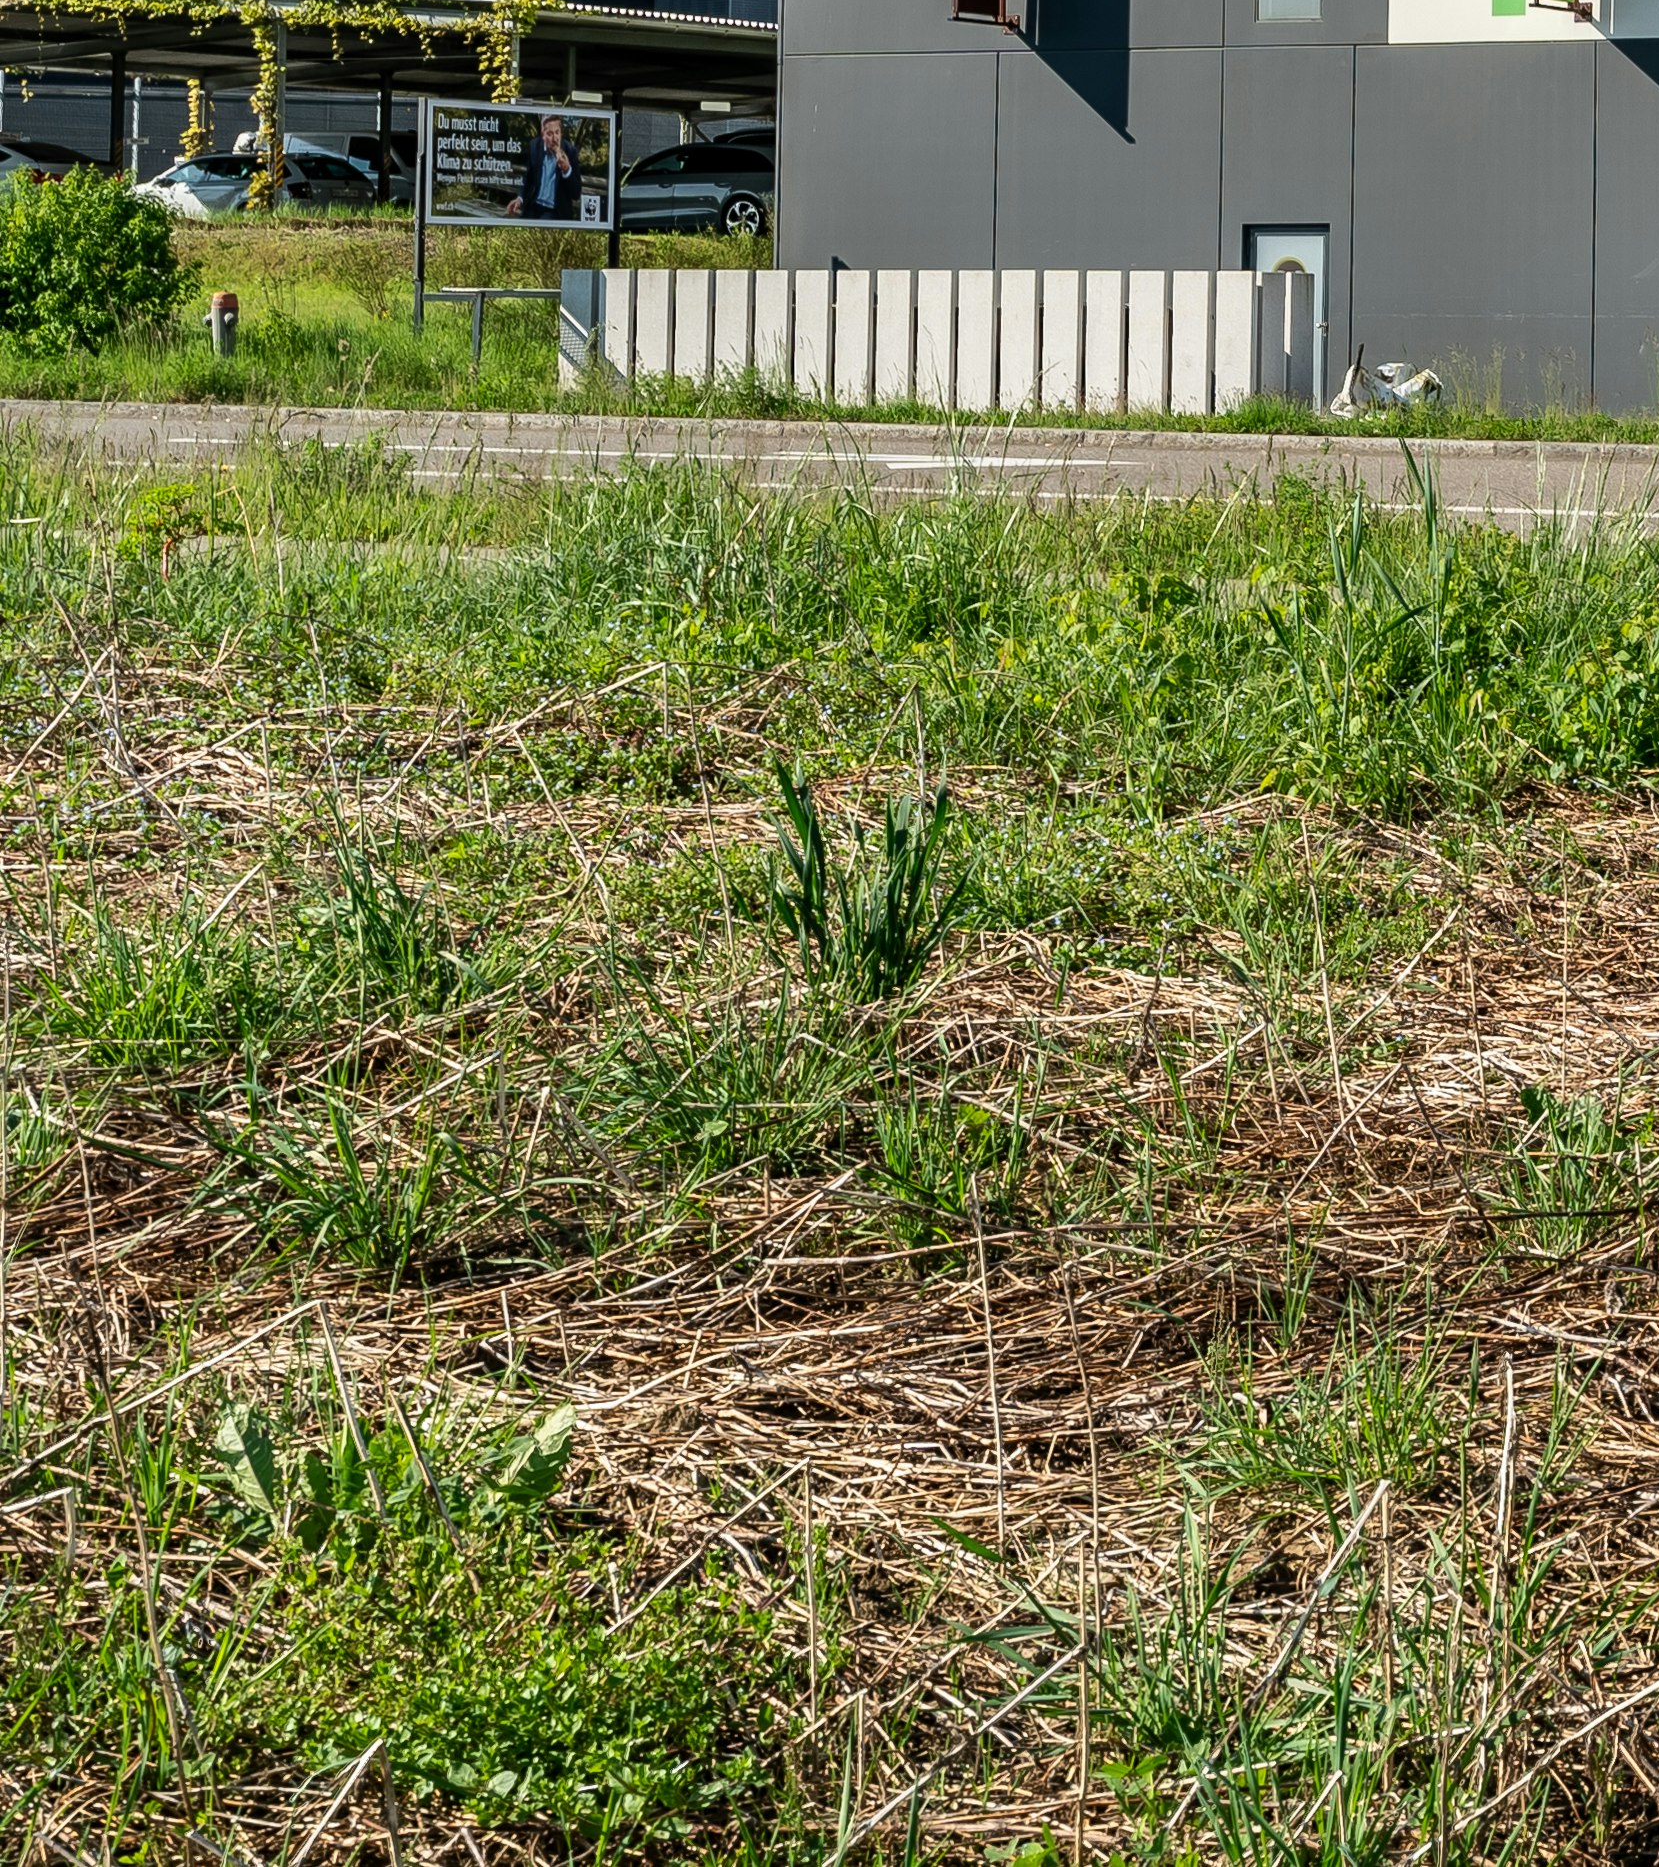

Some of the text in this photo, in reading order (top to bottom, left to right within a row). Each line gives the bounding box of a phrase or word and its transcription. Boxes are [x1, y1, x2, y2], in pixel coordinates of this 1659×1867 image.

[438, 113, 499, 133] Du musst nicht
[437, 133, 522, 154] perfekt sein, um das
[437, 152, 513, 172] Klima zu schützen.
